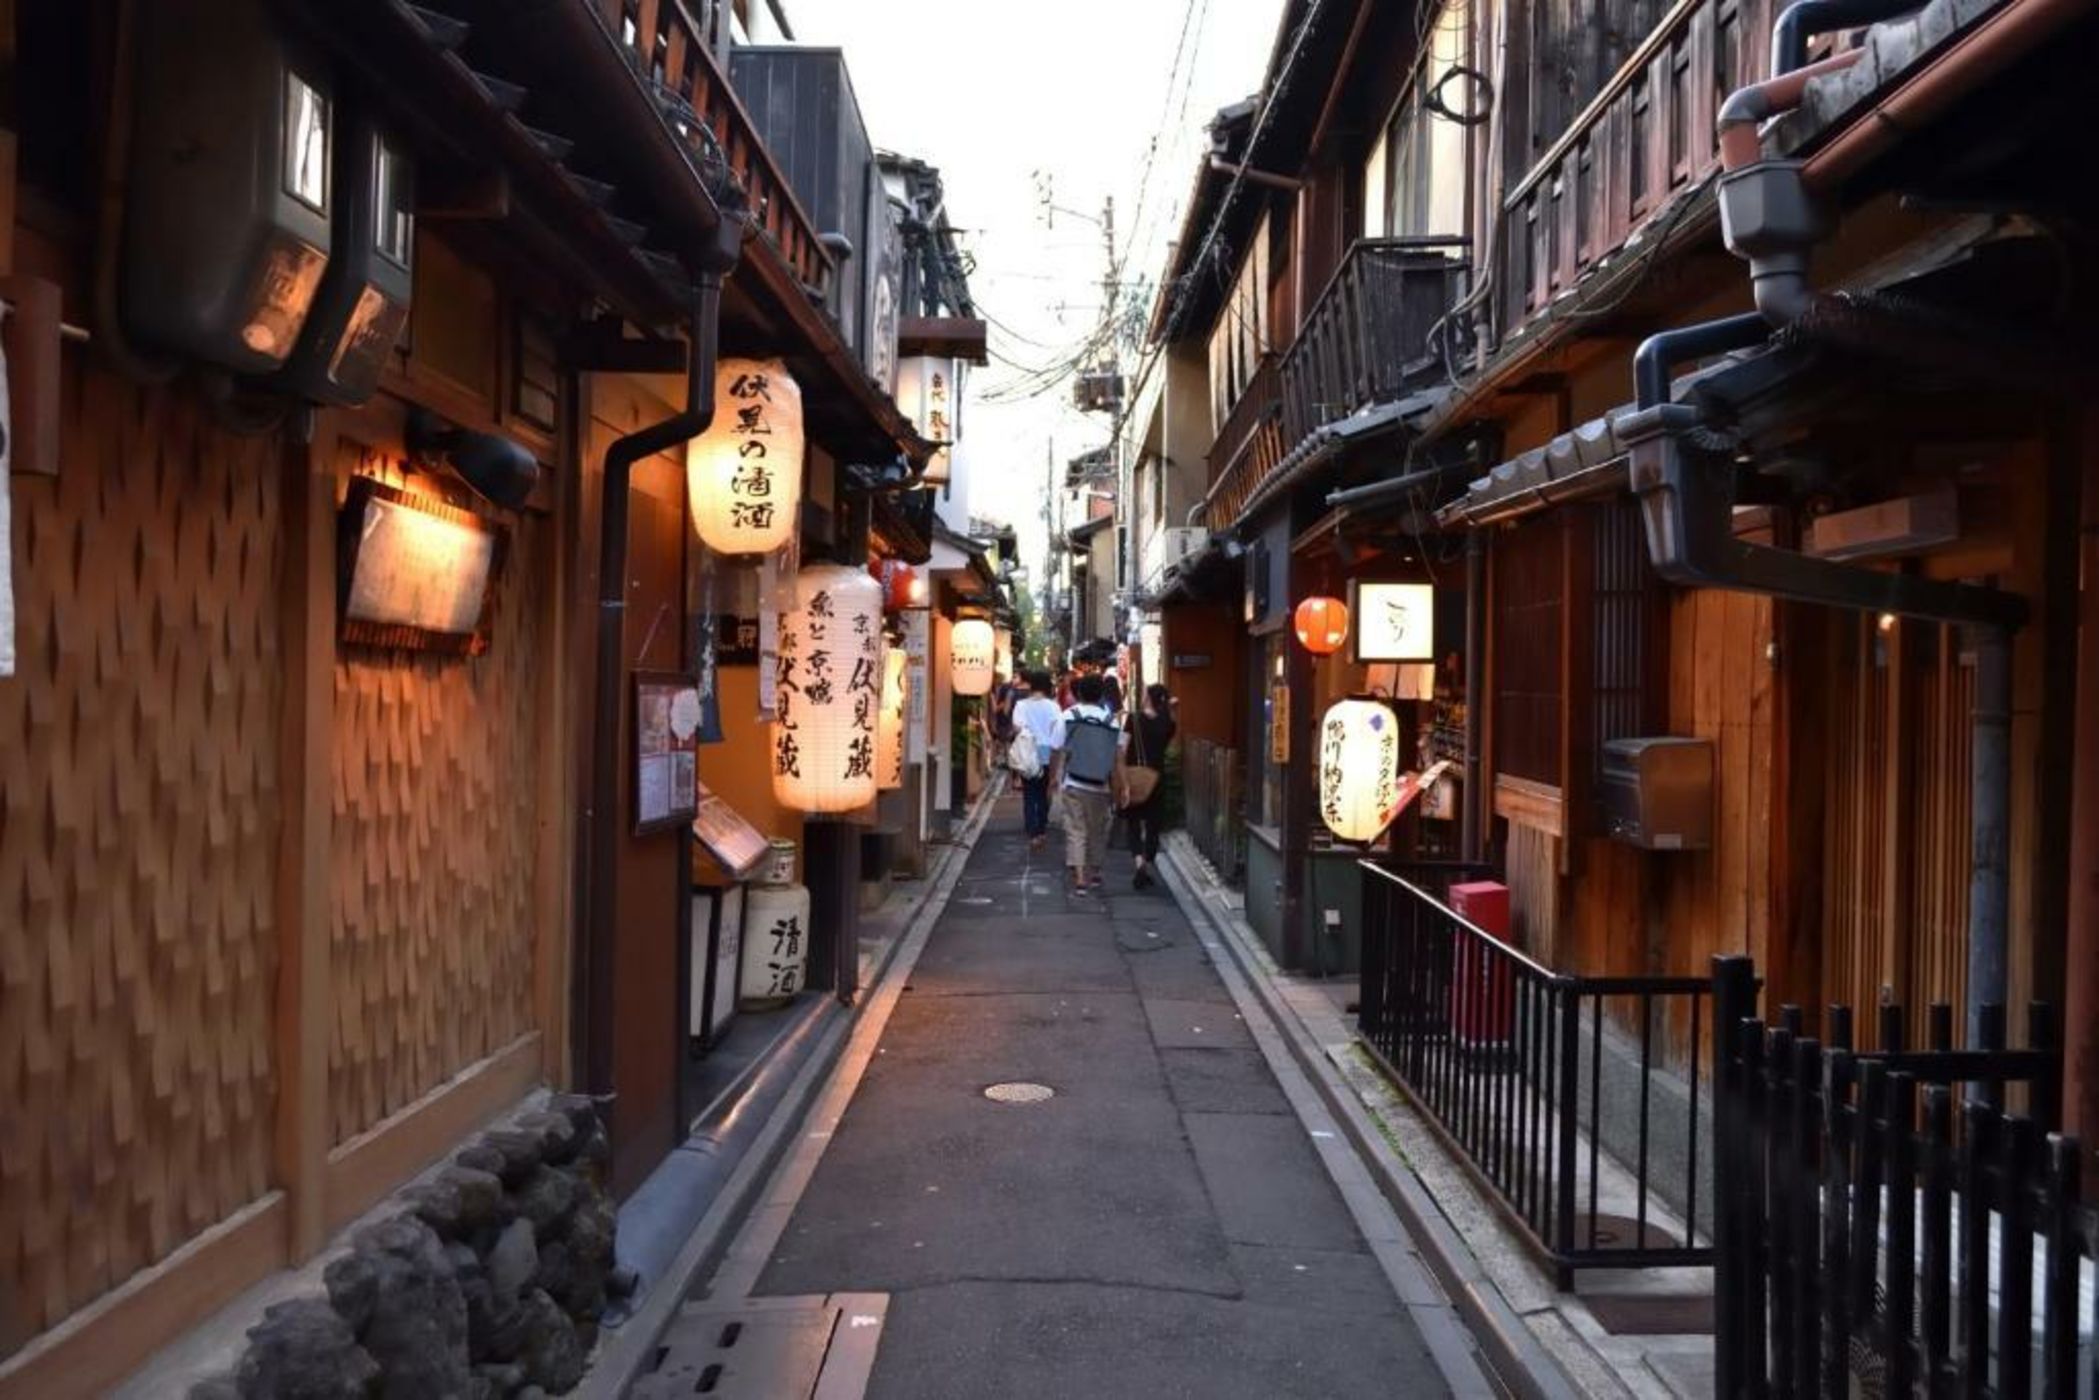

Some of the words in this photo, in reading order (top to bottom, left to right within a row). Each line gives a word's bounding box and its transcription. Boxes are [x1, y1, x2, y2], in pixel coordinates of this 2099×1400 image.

[730, 374, 774, 528] 伏見の清酒
[769, 915, 802, 995] 清酒
